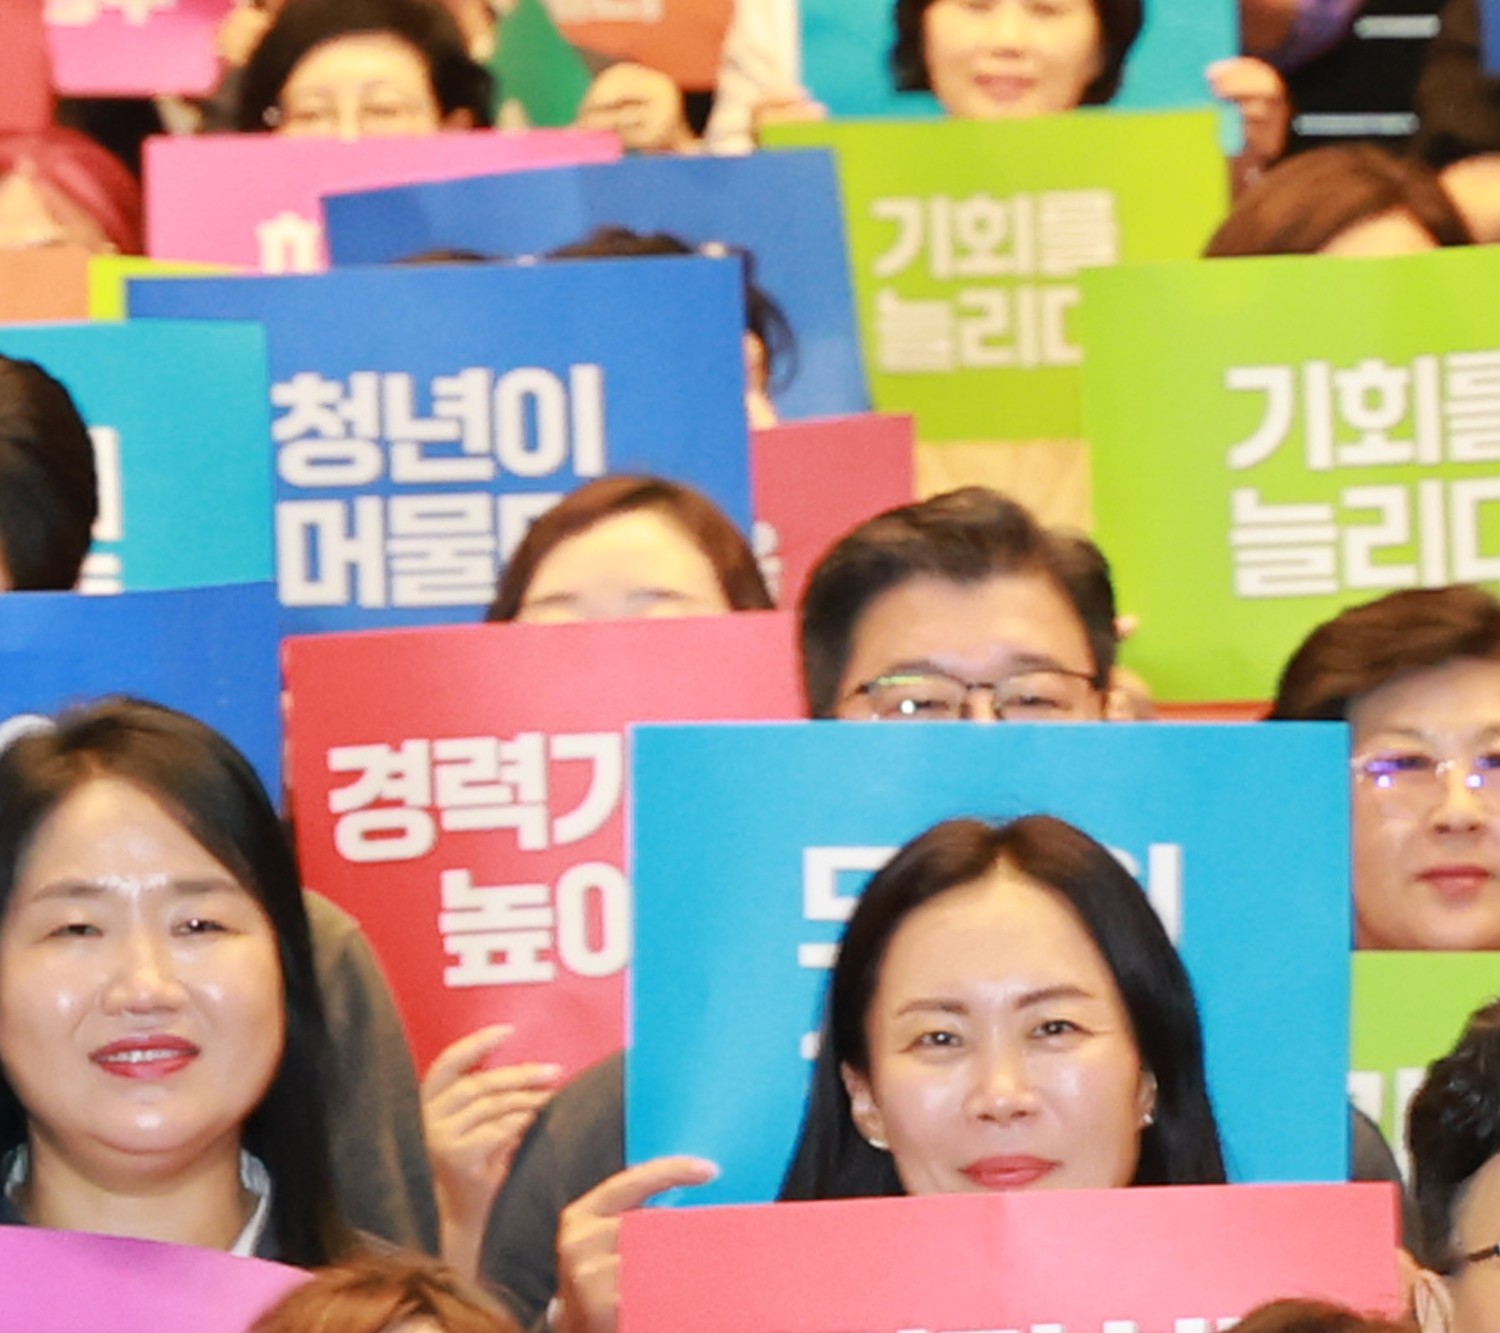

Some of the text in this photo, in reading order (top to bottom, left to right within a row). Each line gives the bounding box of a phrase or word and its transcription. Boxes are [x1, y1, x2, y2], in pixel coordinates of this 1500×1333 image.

[872, 187, 1121, 280] 기회를
[270, 365, 605, 488] 청년이
[277, 495, 568, 608] 머물
